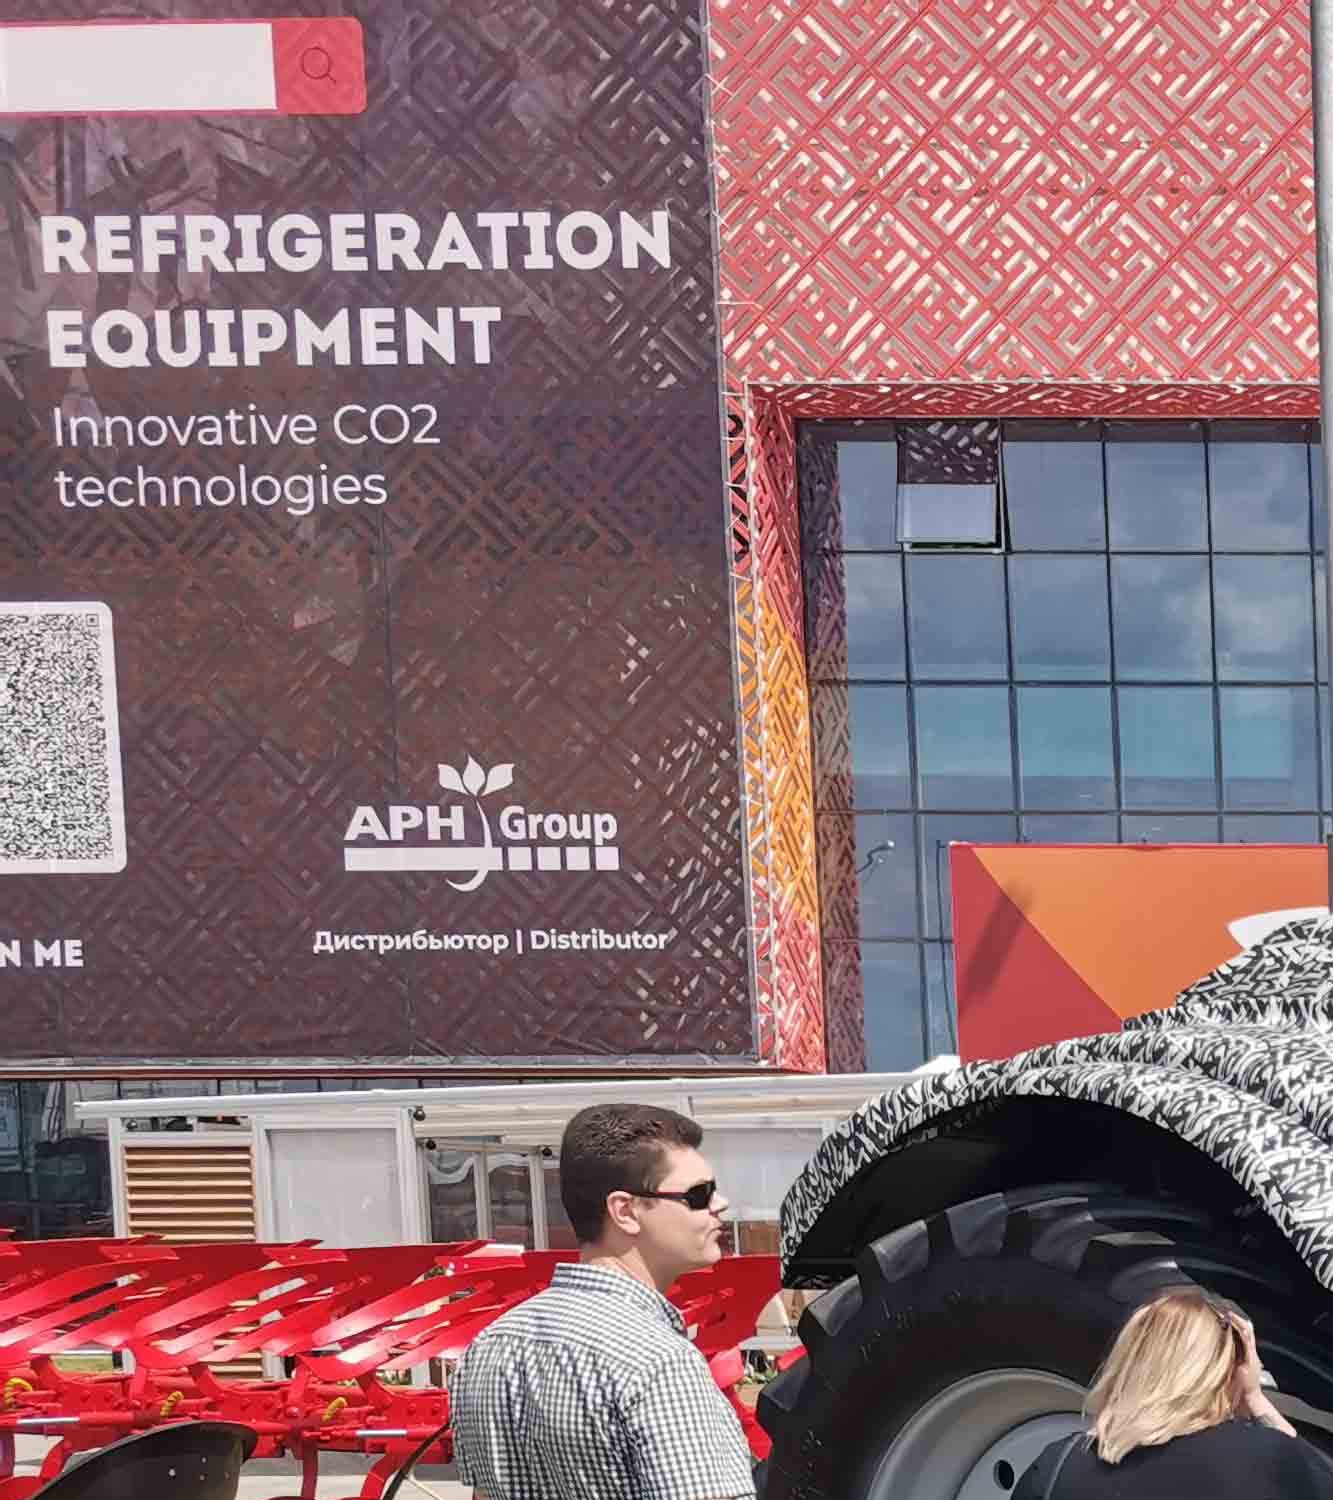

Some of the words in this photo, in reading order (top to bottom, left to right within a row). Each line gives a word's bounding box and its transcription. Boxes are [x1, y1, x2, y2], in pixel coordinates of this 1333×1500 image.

[40, 210, 672, 274] REFRIGERATION
[46, 306, 502, 369] EQUIPMENT
[53, 404, 318, 448] Innovative
[333, 402, 442, 445] CO2
[53, 463, 389, 516] technologies
[343, 804, 466, 842] APH
[498, 804, 618, 847] Group
[33, 938, 85, 968] ME
[311, 929, 510, 955] Дистрибьютор
[529, 927, 669, 952] Distributor
